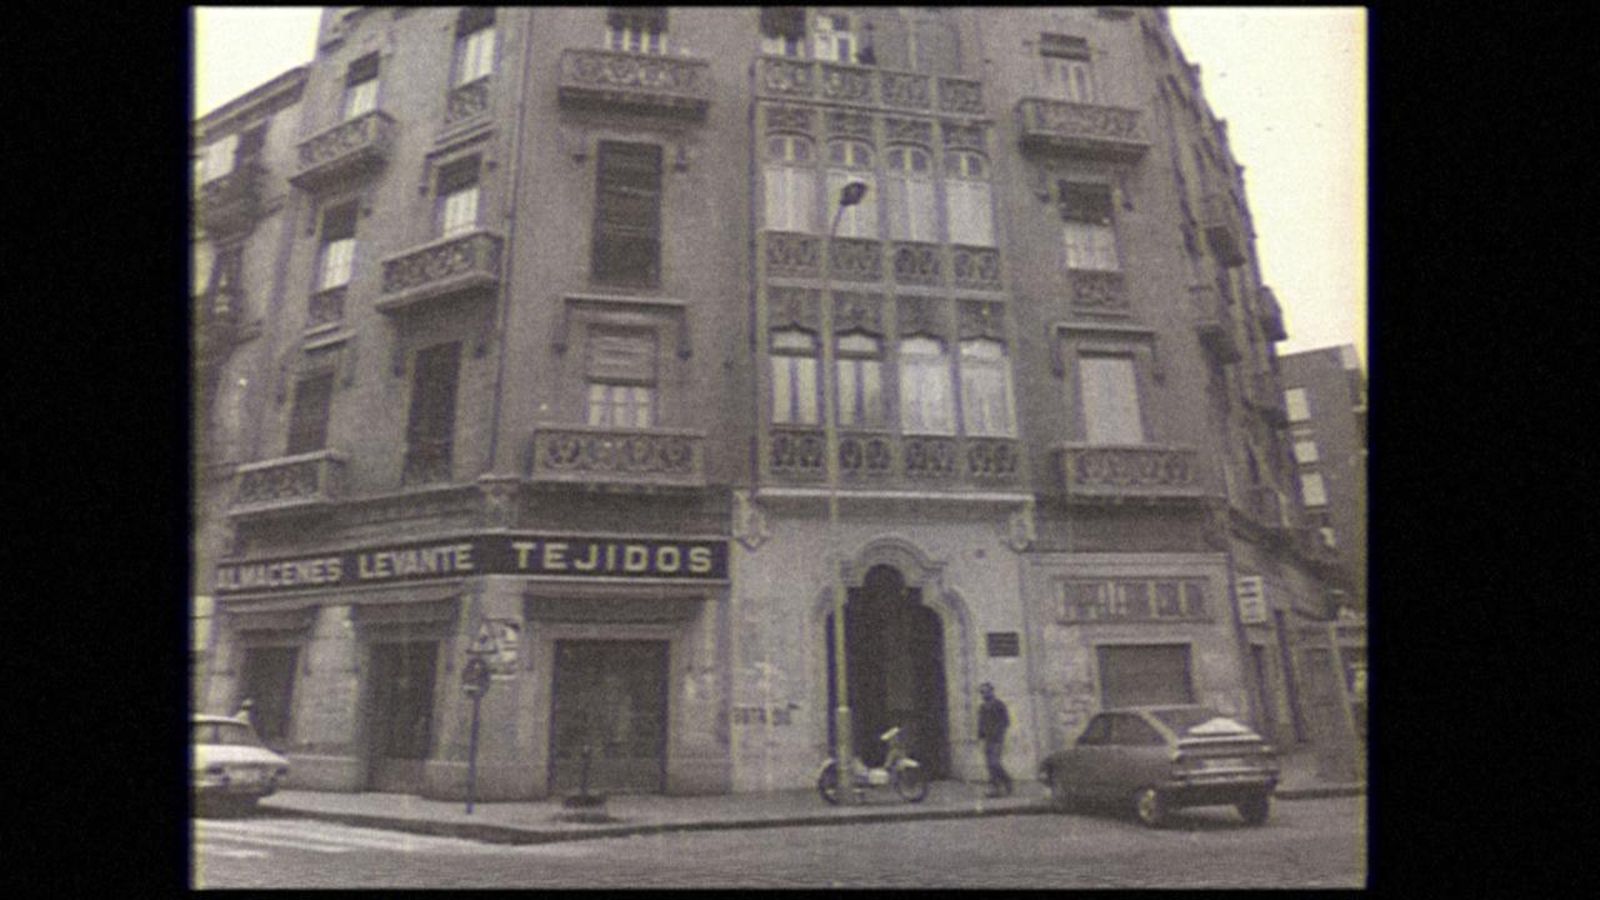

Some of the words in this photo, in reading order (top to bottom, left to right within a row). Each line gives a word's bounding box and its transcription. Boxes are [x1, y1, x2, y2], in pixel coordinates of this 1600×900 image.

[216, 557, 342, 590] ALMACENES
[358, 543, 475, 580] LEVANTE
[512, 541, 712, 573] TEJIDOS
